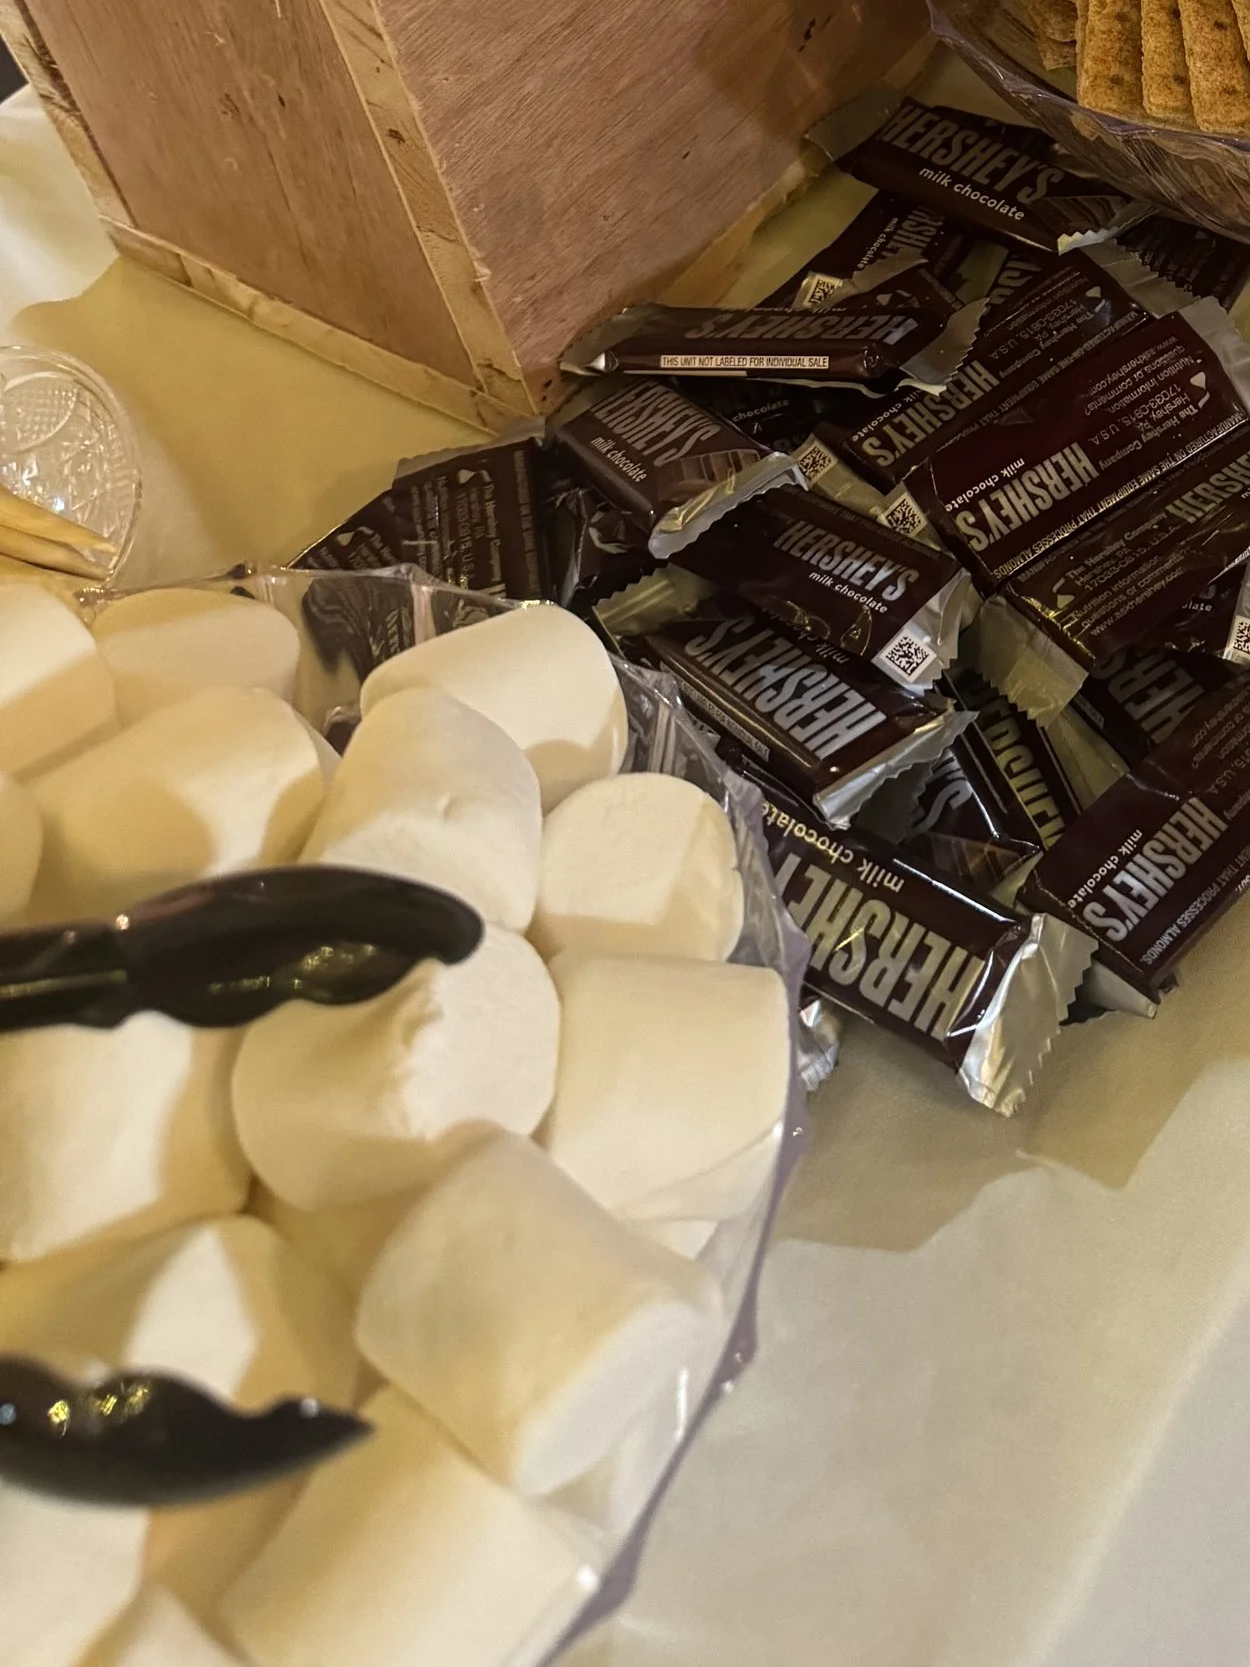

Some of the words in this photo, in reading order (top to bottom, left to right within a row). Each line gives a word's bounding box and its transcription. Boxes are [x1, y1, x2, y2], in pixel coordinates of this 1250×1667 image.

[877, 105, 1065, 204] HERSHEY'S
[919, 166, 951, 188] milk
[953, 180, 1026, 221] chocolate
[662, 356, 679, 367] THIS
[680, 356, 697, 367] UNIT
[698, 356, 714, 367] NOT
[715, 356, 748, 368] LABELED
[750, 356, 764, 368] FOR
[765, 356, 807, 368] INDIVIDUAL
[807, 357, 828, 368] SALE
[732, 399, 790, 422] chocolate
[852, 401, 903, 442] chocolate
[860, 359, 1000, 468] HERSHEY'S
[1139, 411, 1180, 443] Hershey
[1178, 402, 1199, 420] The
[1184, 407, 1247, 453] MANUFACTURED
[590, 435, 610, 455] milk
[607, 450, 648, 483] chocolate
[1001, 457, 1025, 479] milk
[1095, 435, 1143, 471] Company
[1157, 454, 1175, 470] THE
[1172, 446, 1187, 460] ON
[945, 474, 999, 512] chocolate
[1136, 463, 1161, 484] SAME
[956, 442, 1100, 552] HERSHEY'S
[1093, 477, 1140, 512] EQUIPMENT
[1075, 505, 1097, 524] THAT
[1031, 518, 1078, 553] PROCESSES
[772, 521, 920, 602] HERSHEY'S
[809, 570, 833, 588] milk
[834, 582, 888, 615] chocolate
[684, 616, 887, 760] HERSHEY'S
[762, 801, 855, 865] chocolate
[1117, 829, 1143, 857] milk
[857, 857, 905, 893] milk
[1067, 852, 1120, 910] chocolate
[1083, 797, 1229, 942] HERSHEY'S
[1174, 881, 1222, 930] PROCESSES
[1137, 922, 1182, 968] ALMONDS.
